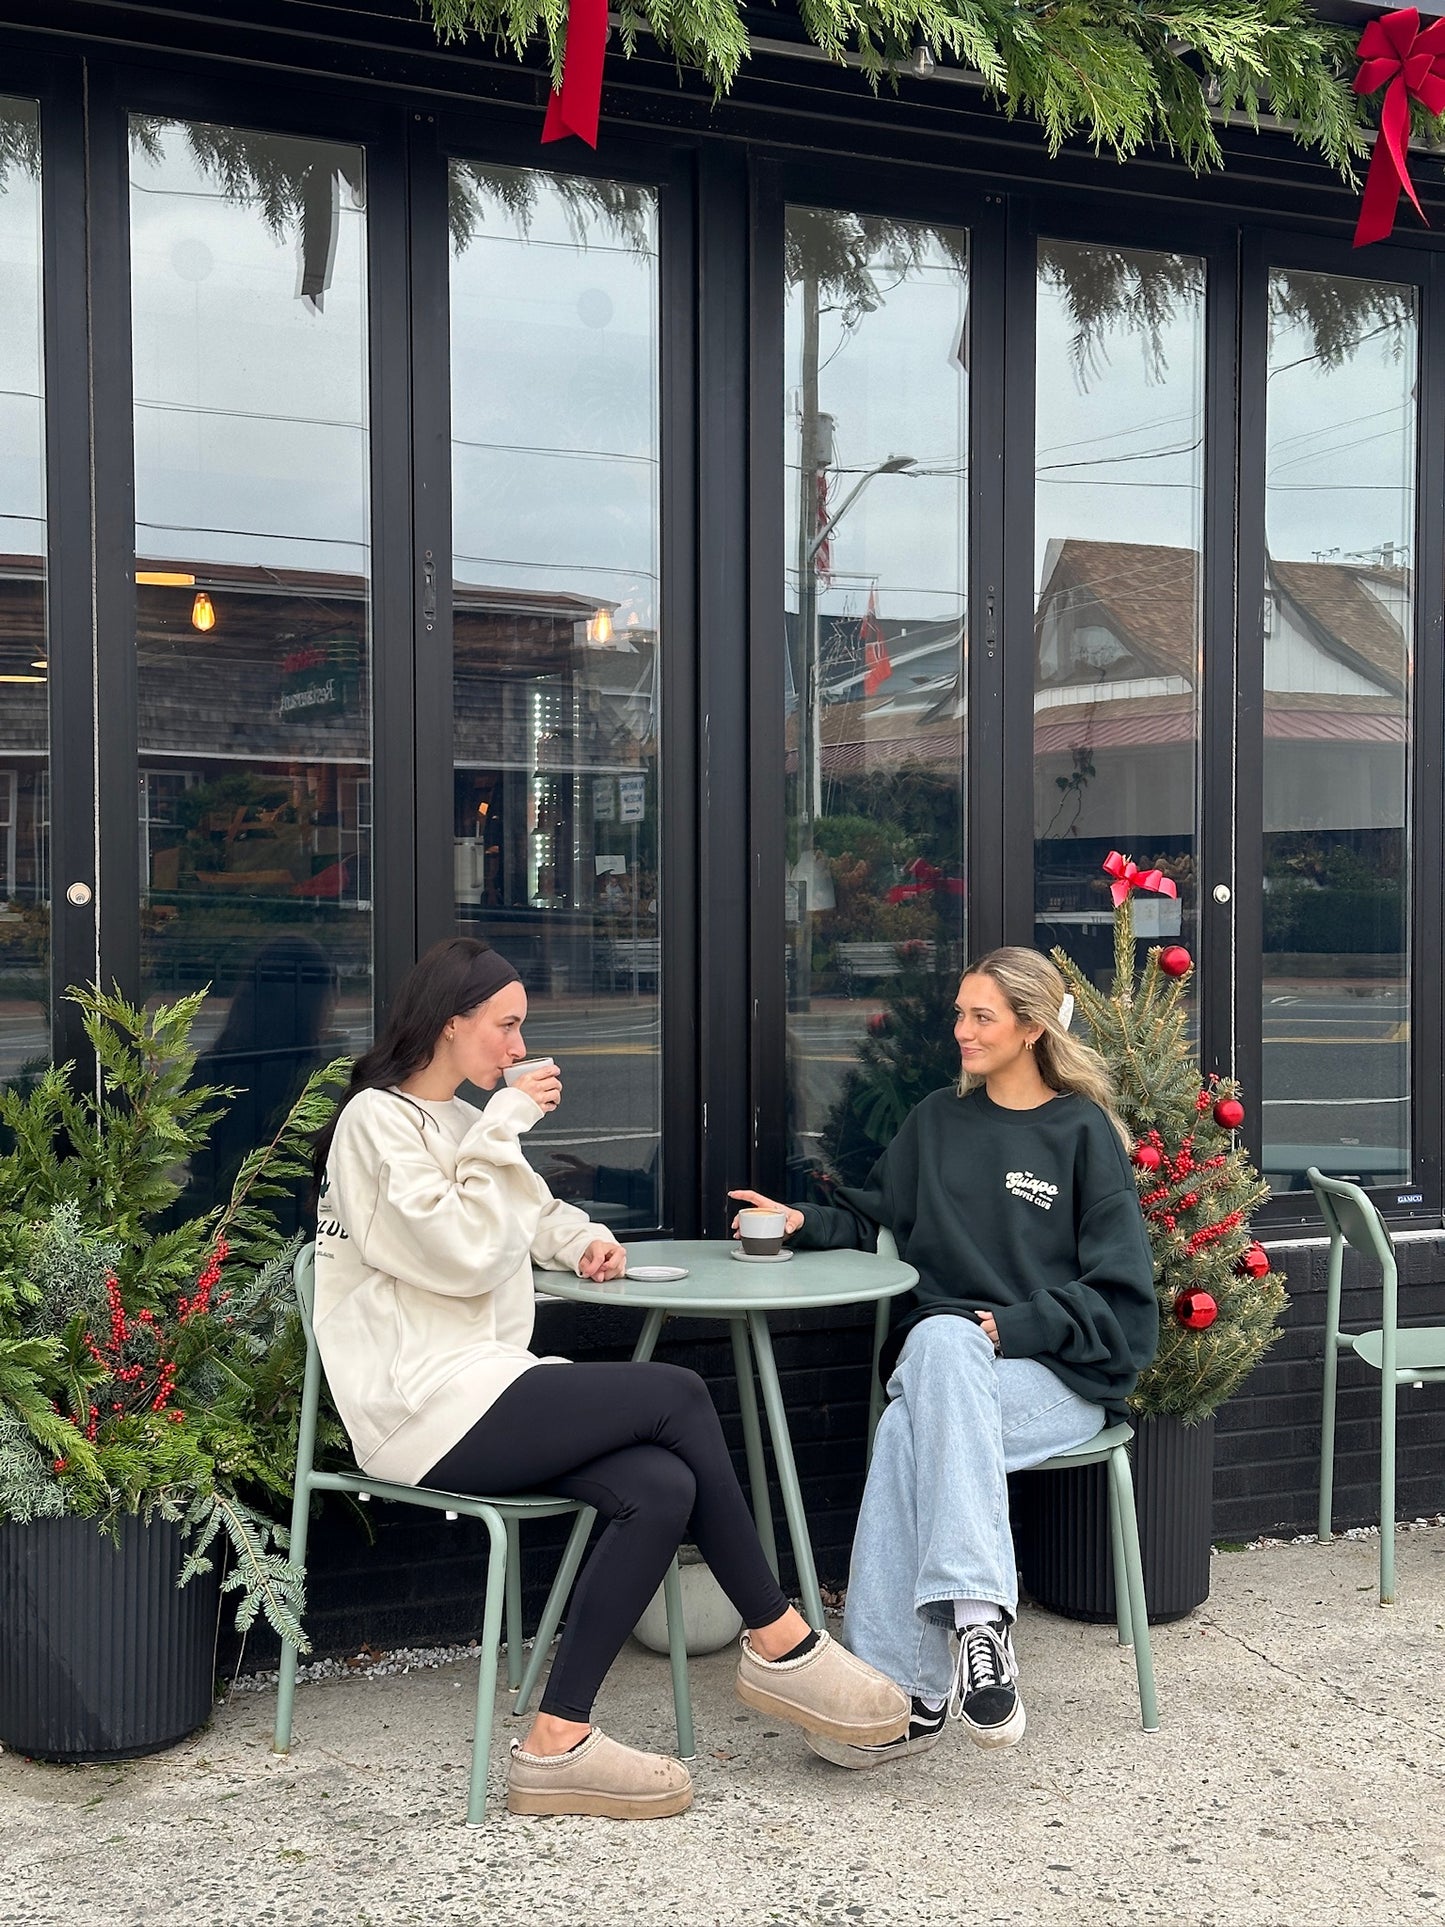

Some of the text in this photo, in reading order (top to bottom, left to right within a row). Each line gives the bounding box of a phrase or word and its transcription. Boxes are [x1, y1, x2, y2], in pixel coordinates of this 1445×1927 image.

[1005, 1171, 1059, 1195] Guapo
[1011, 1187, 1035, 1202] COFFEE
[1034, 1197, 1052, 1210] CLUB
